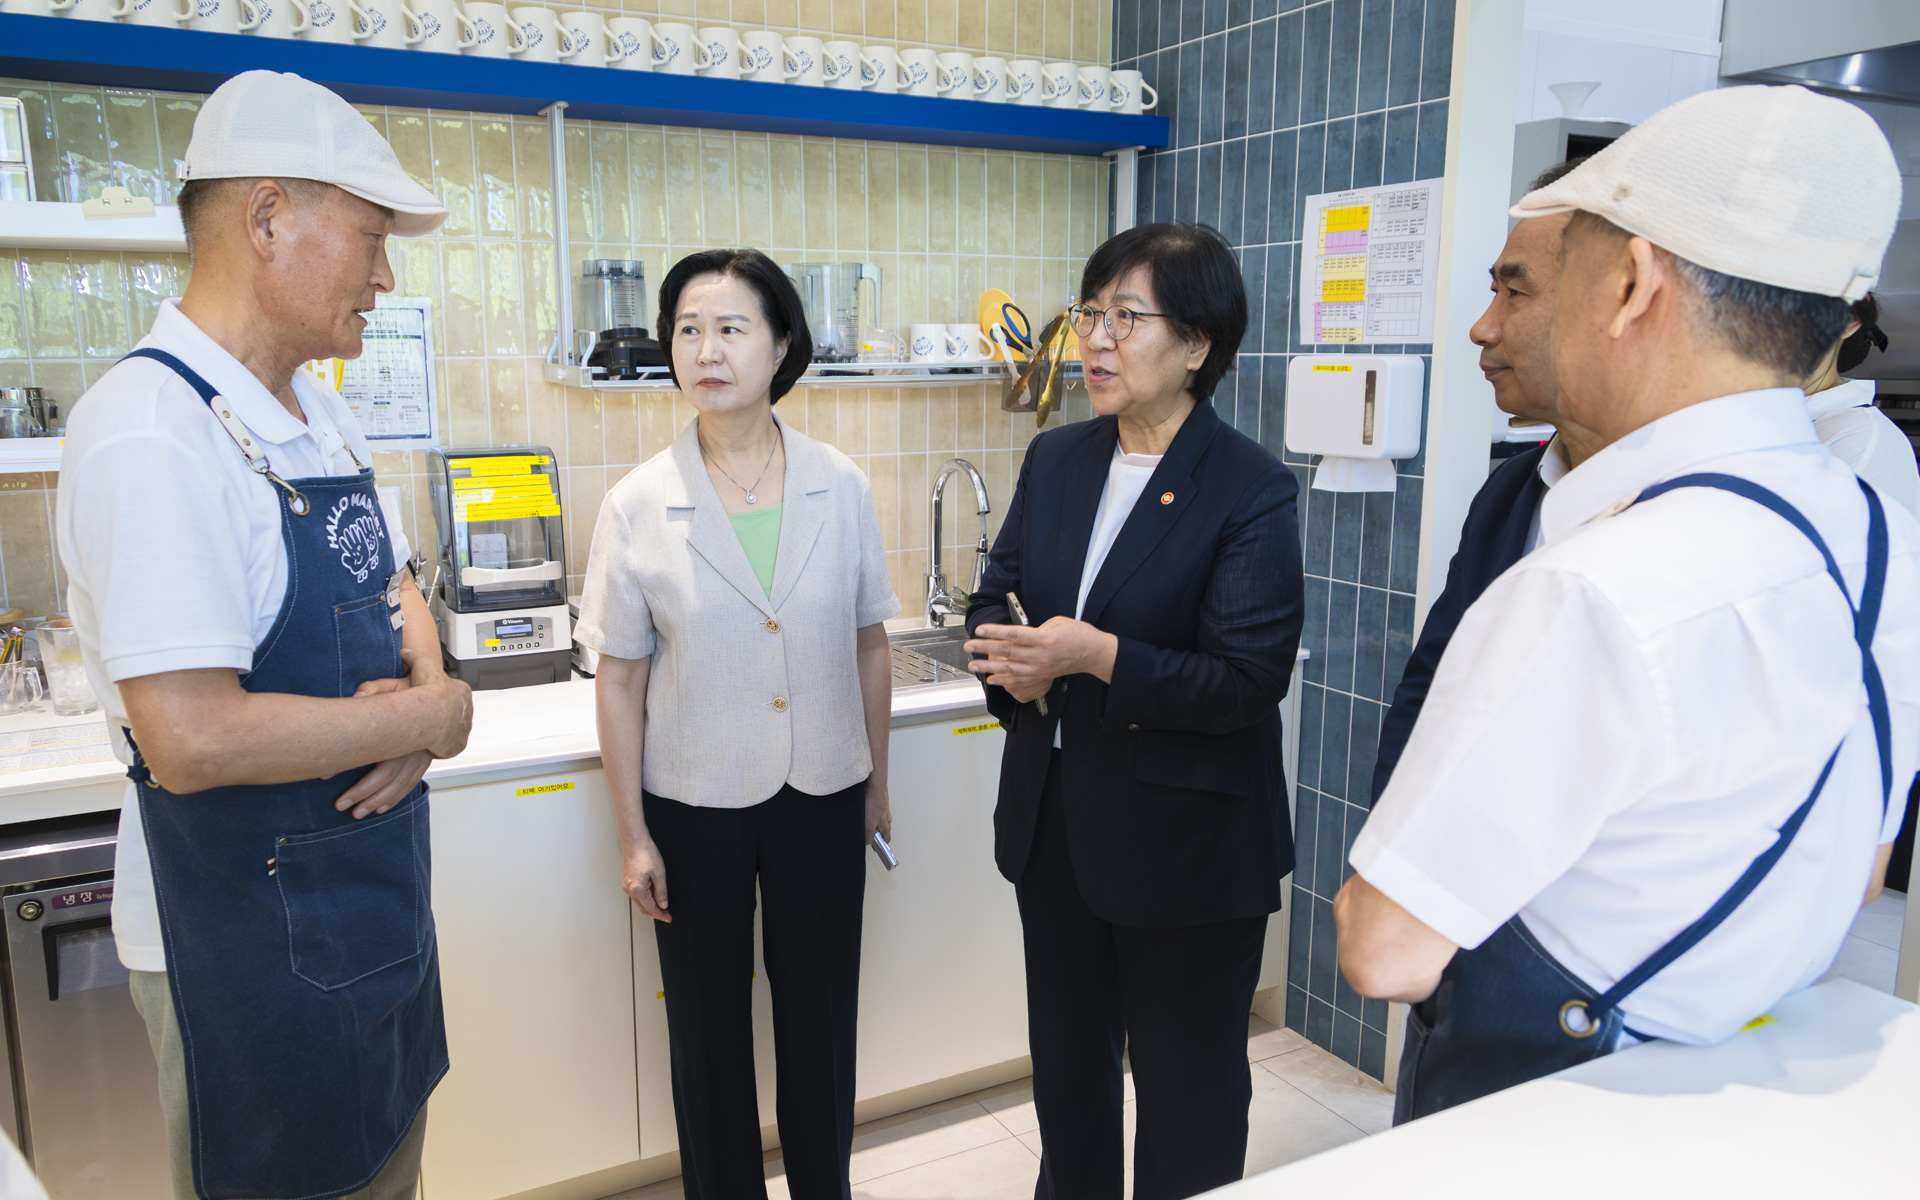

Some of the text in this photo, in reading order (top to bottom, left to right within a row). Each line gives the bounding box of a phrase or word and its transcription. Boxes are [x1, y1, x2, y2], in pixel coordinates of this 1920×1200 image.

[326, 493, 385, 549] HALLO MARKET
[538, 782, 569, 792] 여기있어요
[63, 894, 75, 905] 냉
[80, 892, 93, 902] 장
